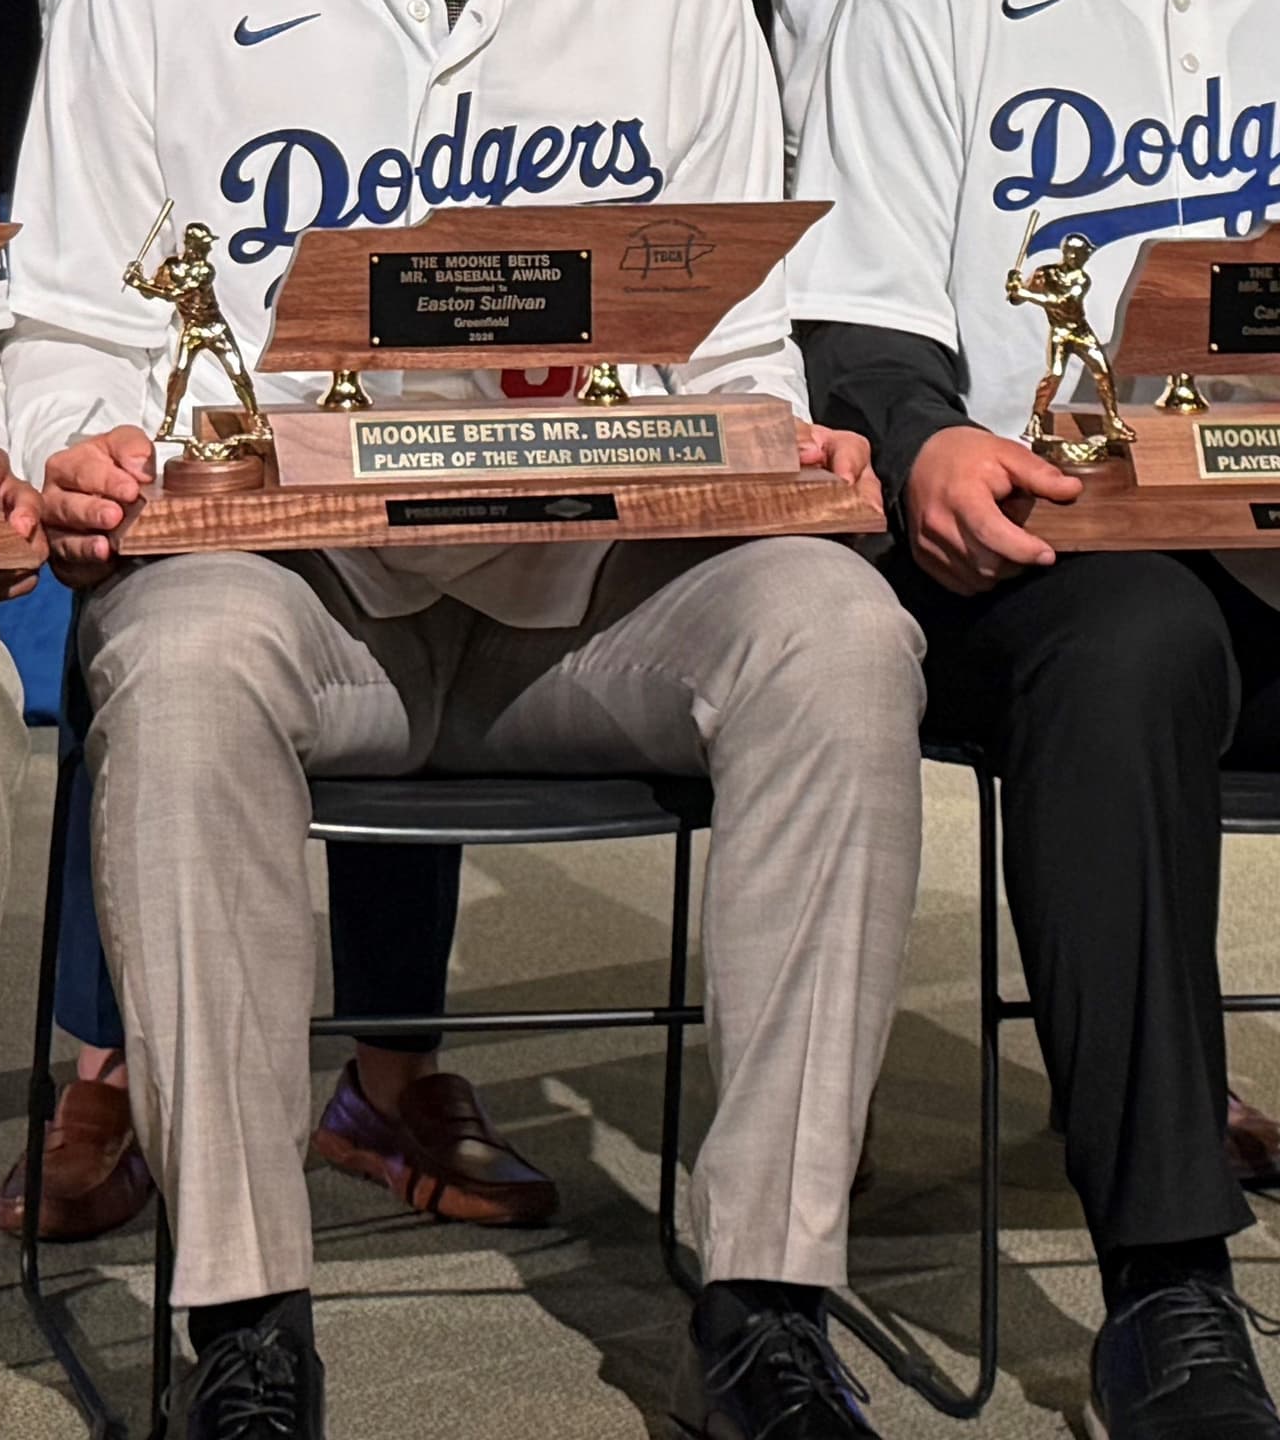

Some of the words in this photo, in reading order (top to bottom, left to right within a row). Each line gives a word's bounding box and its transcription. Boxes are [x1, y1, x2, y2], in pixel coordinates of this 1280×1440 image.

[220, 92, 663, 264] Dodgers
[411, 257, 438, 269] THE
[446, 256, 500, 268] MOOKIE
[509, 255, 550, 266] BETTS
[401, 272, 427, 283] MR.
[436, 270, 504, 282] BASEBALL
[512, 269, 561, 280] AWARD
[1249, 268, 1272, 278] THE
[1238, 281, 1263, 292] MR.
[417, 296, 474, 312] Easton
[480, 296, 546, 310] Sullivan
[362, 424, 456, 445] MOOKIE
[464, 422, 535, 443] BETTS
[543, 421, 588, 441] MR.
[596, 419, 714, 440] BASEBALL
[374, 452, 444, 469] PLAYER
[451, 452, 476, 467] OF
[483, 451, 518, 466] THE
[524, 450, 572, 465] YEAR
[579, 448, 661, 463] DIVISION
[669, 447, 706, 461] I-1A
